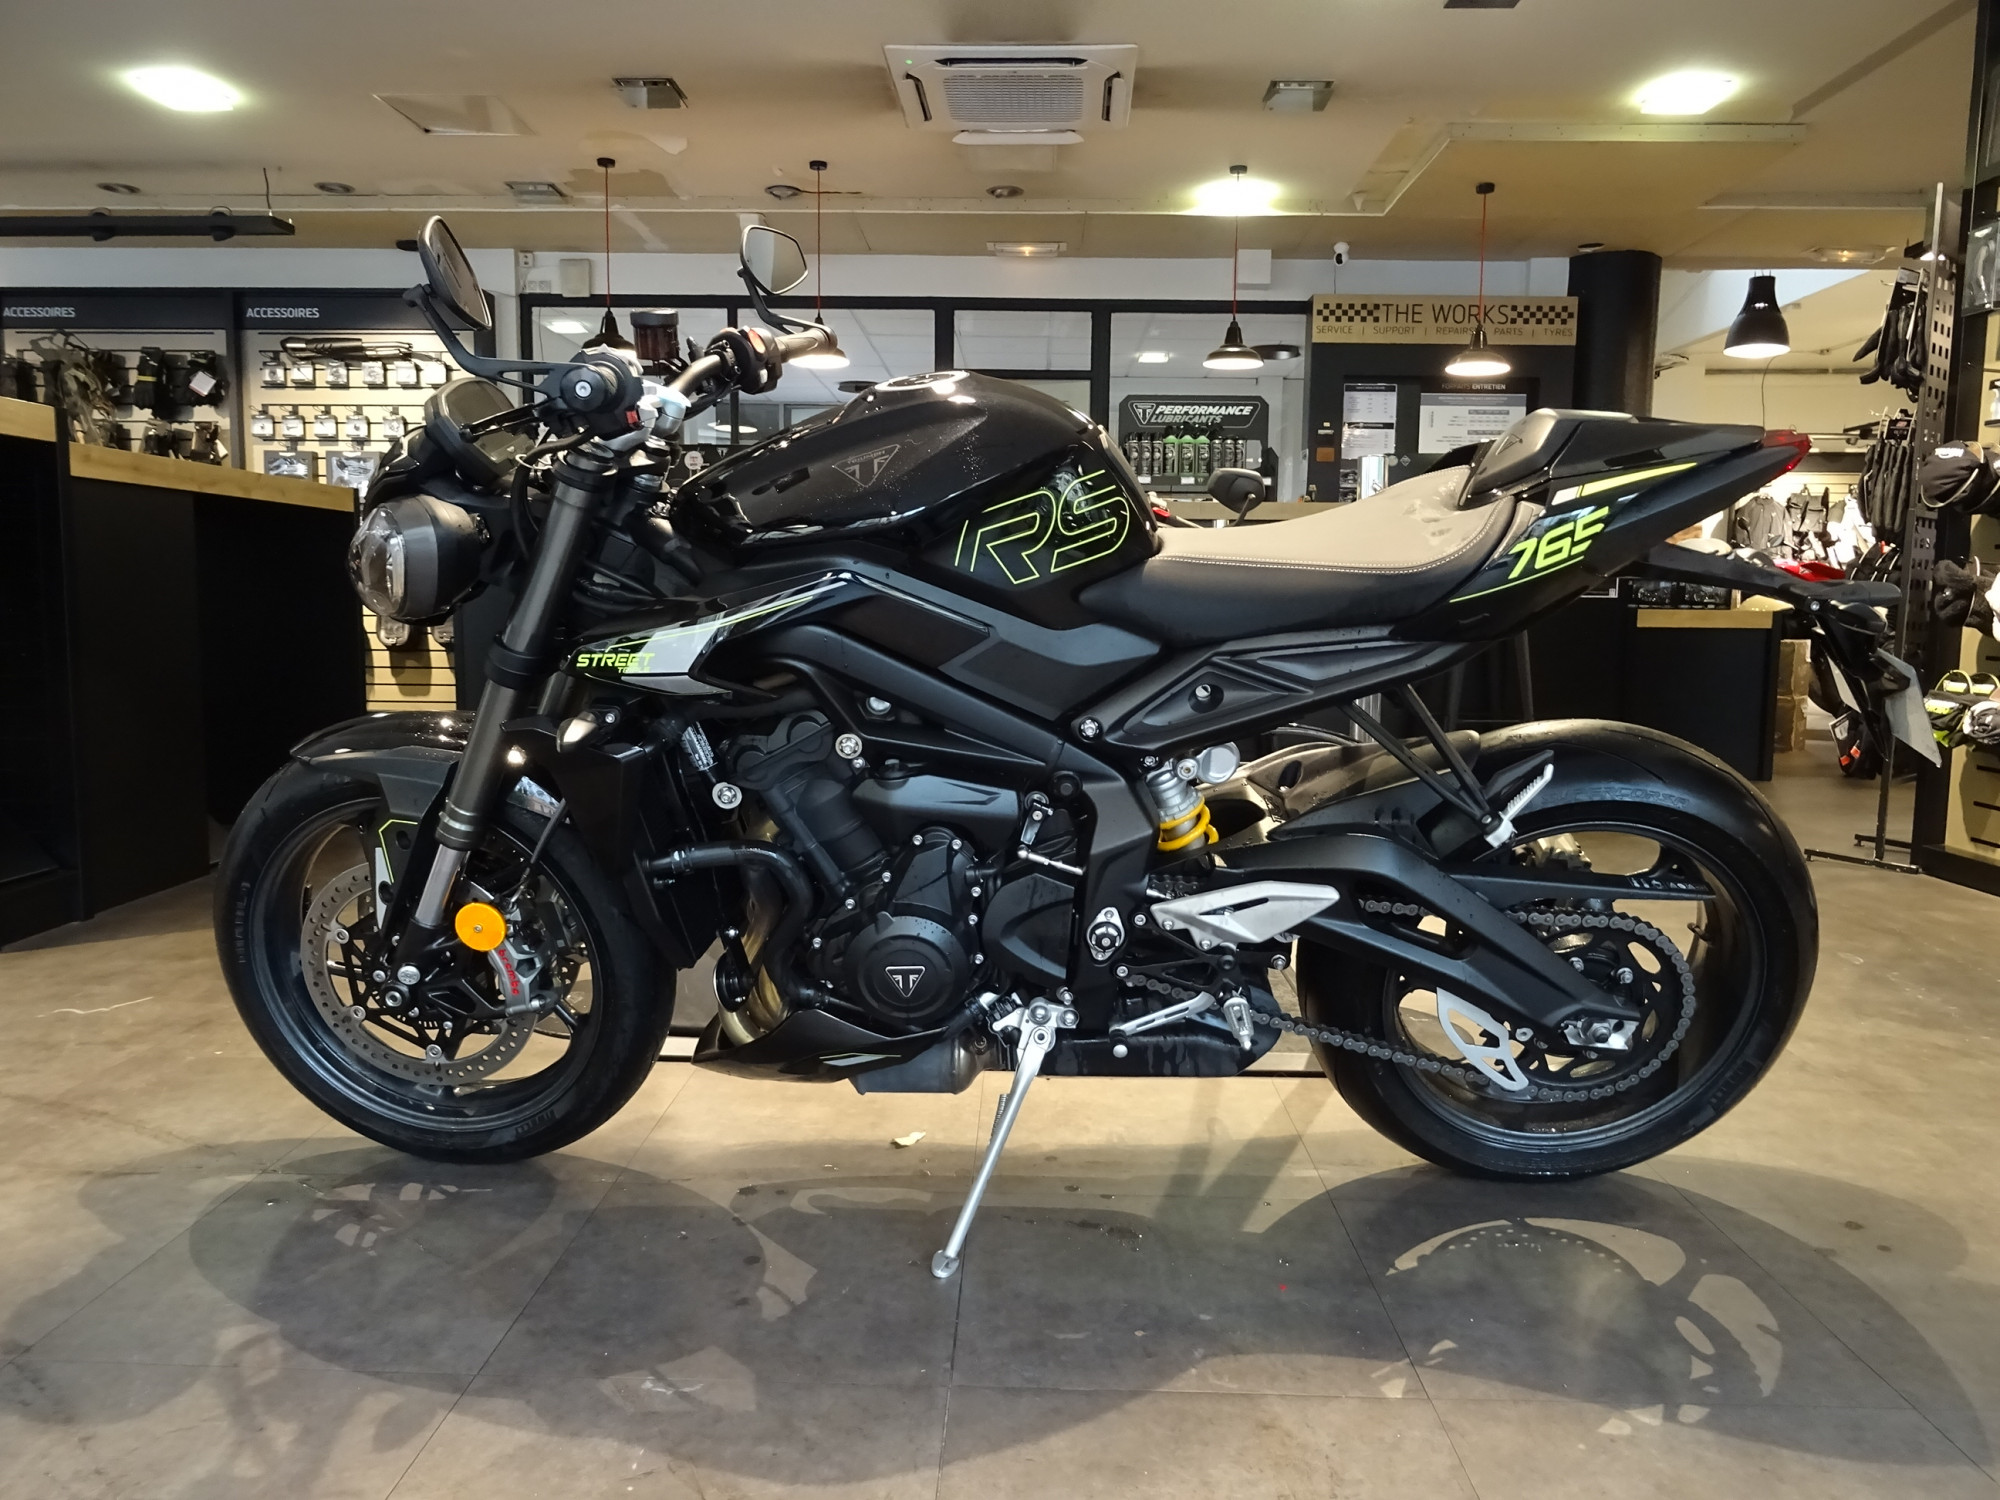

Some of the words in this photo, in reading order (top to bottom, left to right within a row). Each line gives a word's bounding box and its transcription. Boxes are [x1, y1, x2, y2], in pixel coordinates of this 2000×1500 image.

[2, 307, 76, 318] ACCESSOIRES
[246, 307, 320, 319] ACCESSOIRES
[1380, 303, 1424, 323] THE
[1432, 304, 1509, 325] WORKS
[1316, 325, 1353, 334] SERVICE
[1373, 326, 1416, 335] SUPPORT
[1494, 327, 1523, 336] PARTS
[1543, 328, 1573, 337] TYRES
[1471, 383, 1506, 391] ENTRETIEN
[1155, 405, 1254, 416] PERFORMANCE
[1150, 414, 1224, 424] LUBRICANTS
[954, 469, 1130, 585] RS
[1508, 506, 1609, 579] 765
[576, 652, 656, 668] STREET
[498, 948, 519, 996] brembo
